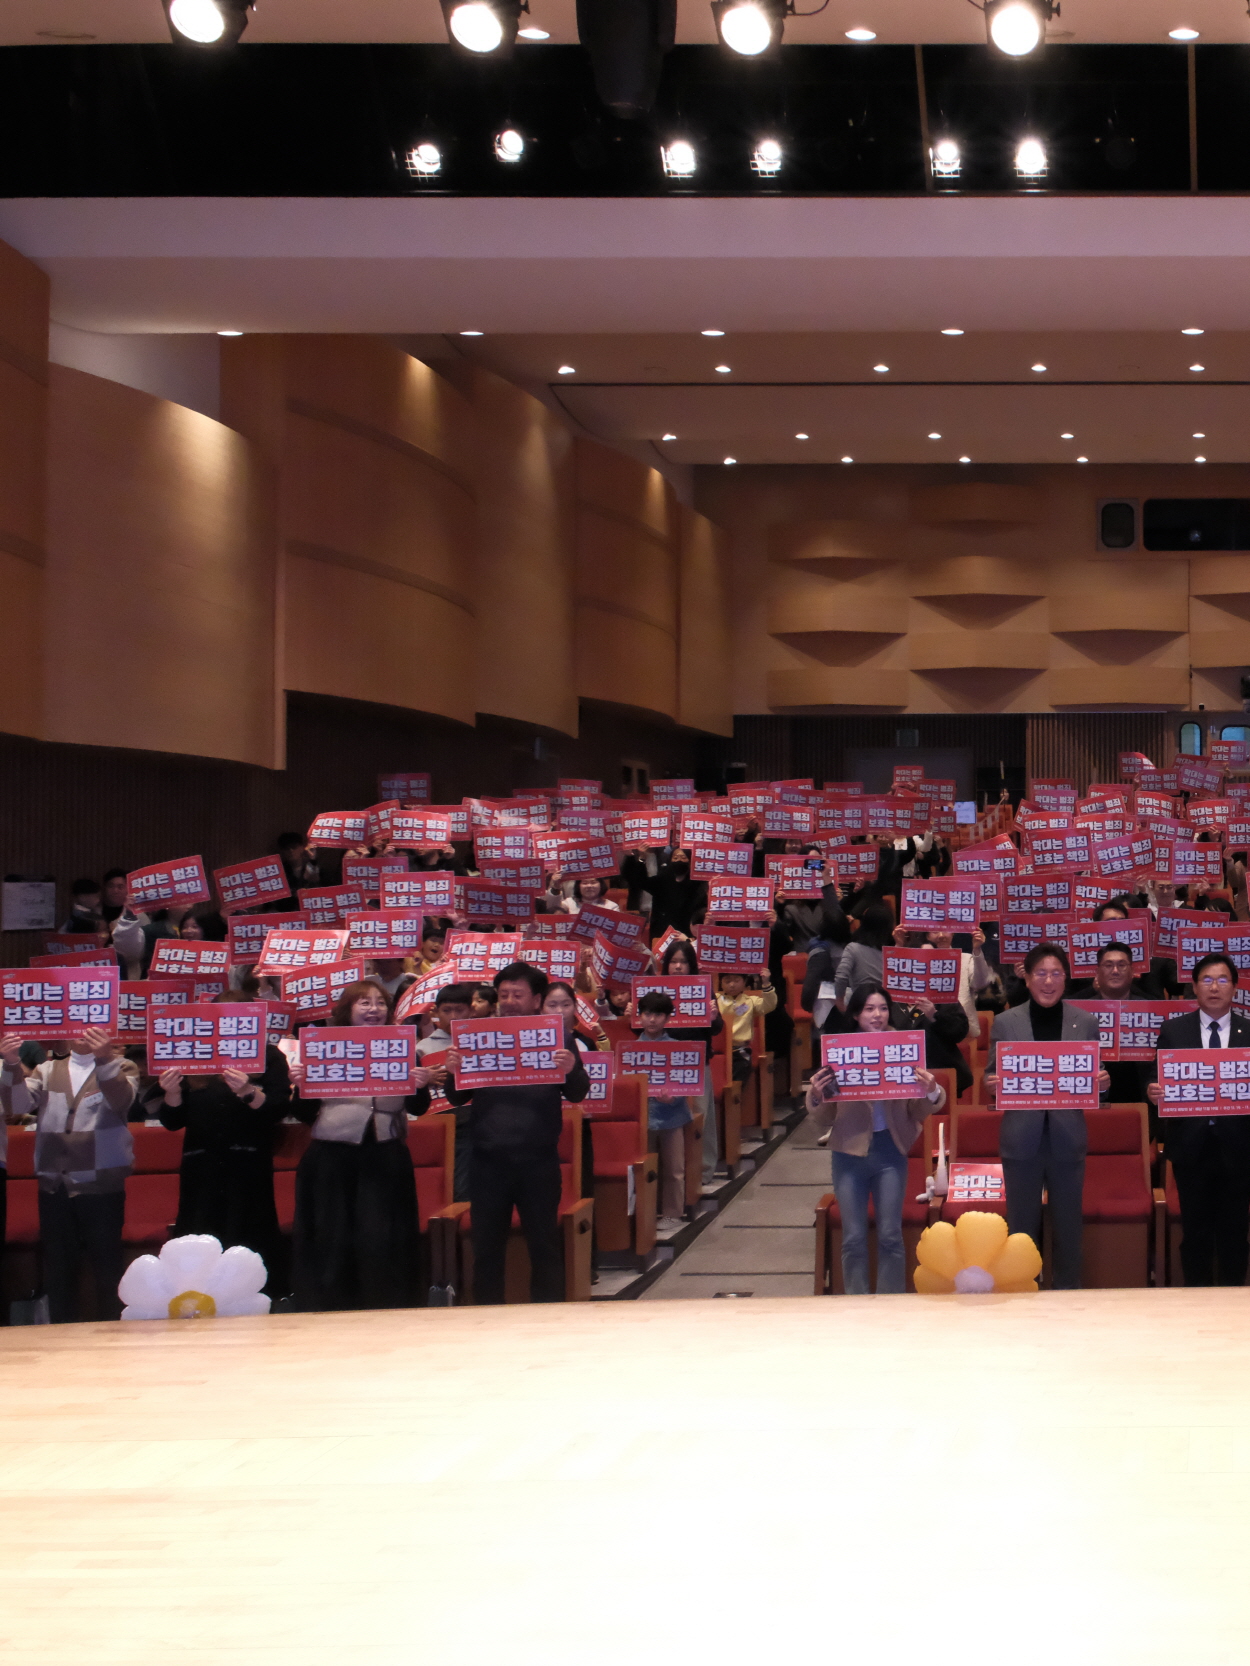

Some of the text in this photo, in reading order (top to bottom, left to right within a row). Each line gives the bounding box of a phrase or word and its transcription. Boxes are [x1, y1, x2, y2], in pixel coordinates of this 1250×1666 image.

[393, 818, 447, 829] 학대는 범죄
[393, 830, 446, 841] 보호는 책임
[1032, 836, 1087, 852] 학대는 범죄
[1034, 850, 1088, 865] 보호는 책임
[131, 866, 198, 891] 학대는 범죄
[385, 880, 449, 892] 학대는 범죄
[174, 880, 202, 893] 책임
[711, 886, 769, 897] 학대는 범죄
[385, 893, 449, 906] 보호는 책임
[906, 889, 974, 904] 학대는 범죄
[710, 900, 770, 910] 보호는 책임
[905, 906, 974, 921] 보호는 책임
[349, 920, 416, 934] 학대는 범죄
[269, 938, 341, 951] 학대는 범죄
[350, 935, 416, 948] 보호는 책임
[701, 934, 764, 948] 학대는 범죄
[264, 953, 337, 965] 보호는 책임
[700, 949, 763, 963] 보호는 책임
[887, 958, 955, 974] 학대는 범죄
[887, 975, 954, 991] 보호는 책임
[3, 981, 109, 1001] 학대는 범죄
[4, 1004, 109, 1024] 보호는 책임
[154, 1017, 257, 1036] 학대는 범죄
[458, 1029, 555, 1050] 학대는 범죄
[154, 1040, 257, 1058] 보호는 책임
[306, 1040, 407, 1059] 학대는 범죄
[827, 1044, 917, 1064] 학대는 범죄
[461, 1050, 559, 1072] 보호는 책임
[1002, 1055, 1091, 1072] 학대는 범죄
[306, 1062, 407, 1081] 보호는 책임
[1163, 1062, 1214, 1080] 학대는
[1002, 1077, 1091, 1094] 보호는 책임
[1162, 1084, 1215, 1101] 보호는
[954, 1175, 1001, 1188] 학대는
